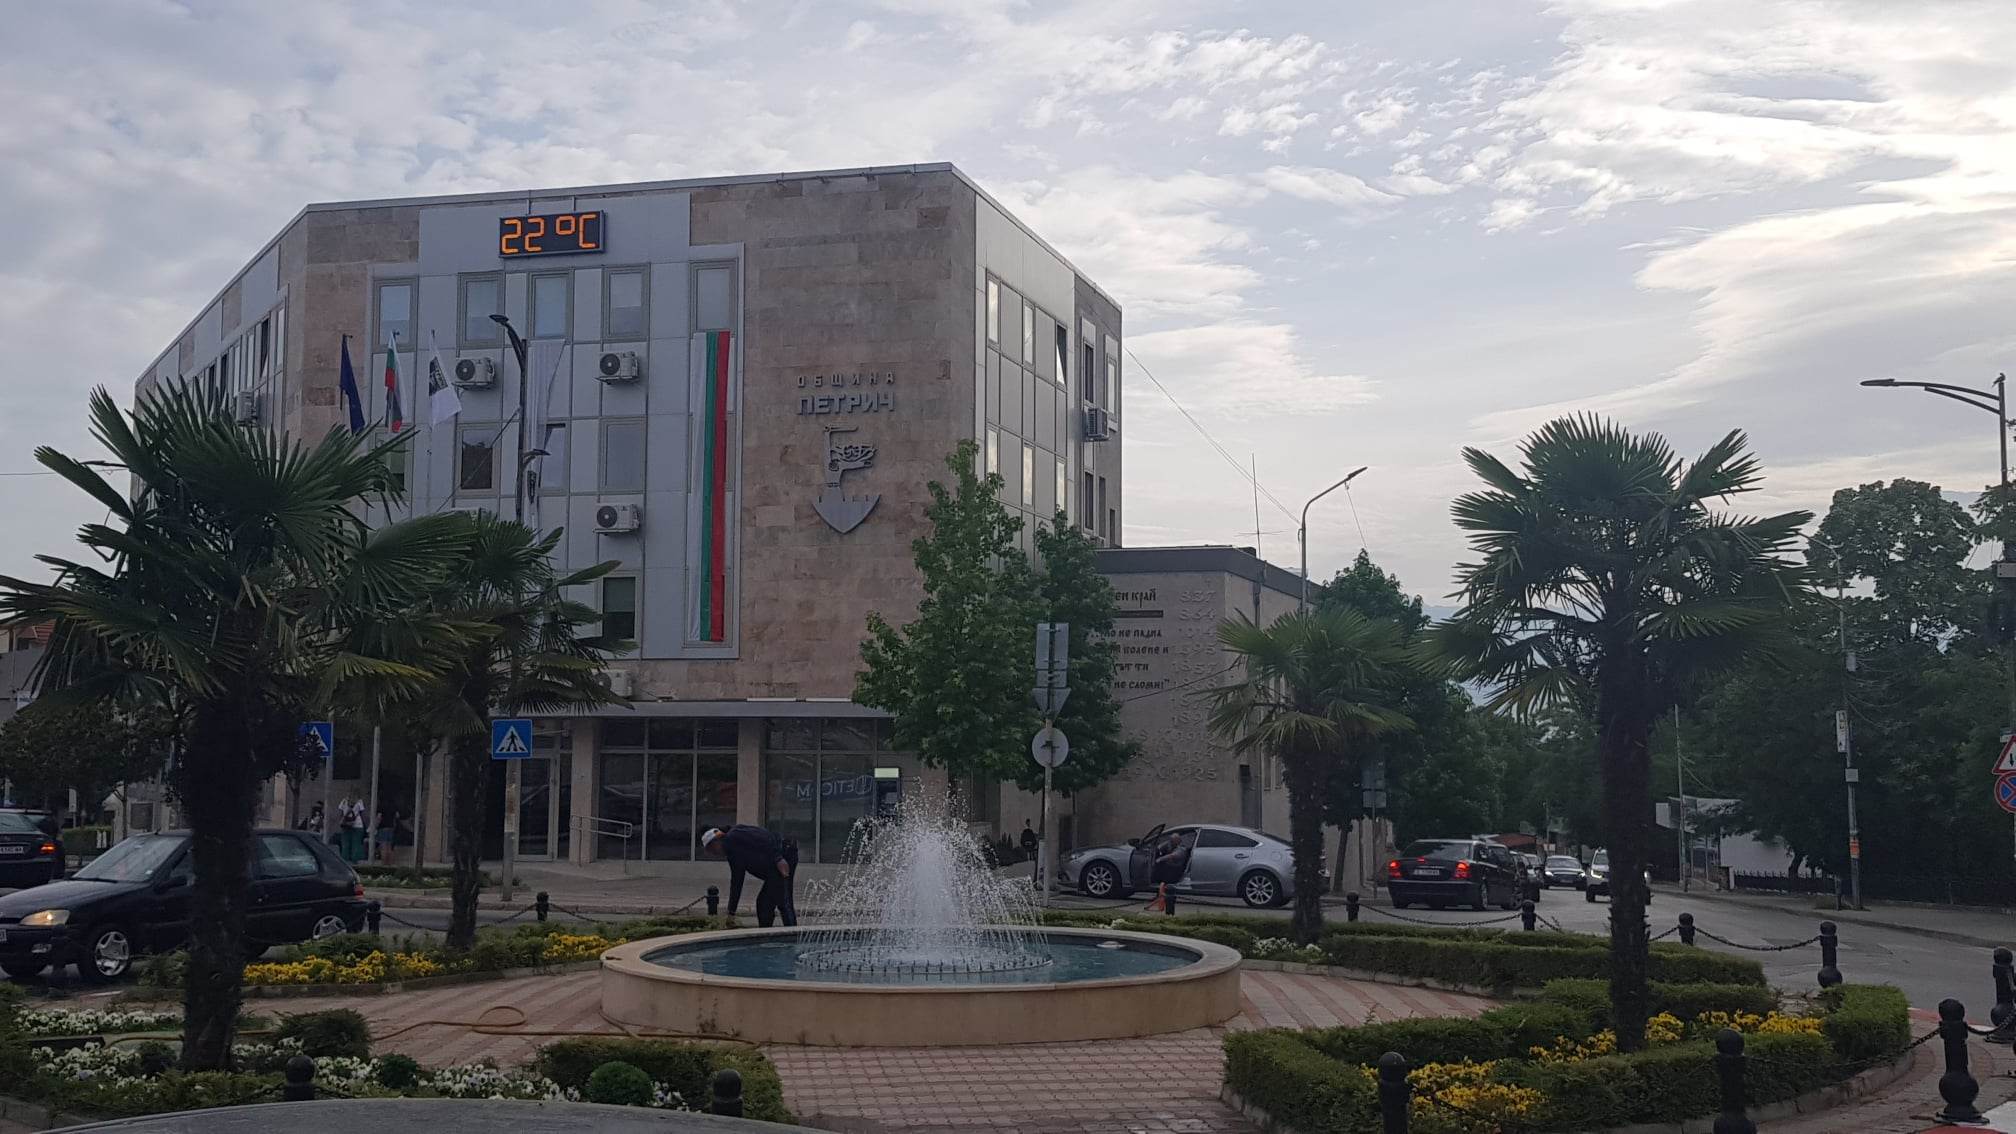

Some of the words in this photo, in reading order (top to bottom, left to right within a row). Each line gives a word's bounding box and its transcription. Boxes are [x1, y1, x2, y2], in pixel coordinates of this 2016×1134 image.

[501, 218, 545, 254] 22
[797, 371, 895, 388] ОБЩИНА
[797, 391, 896, 415] ПЕТРИЧ
